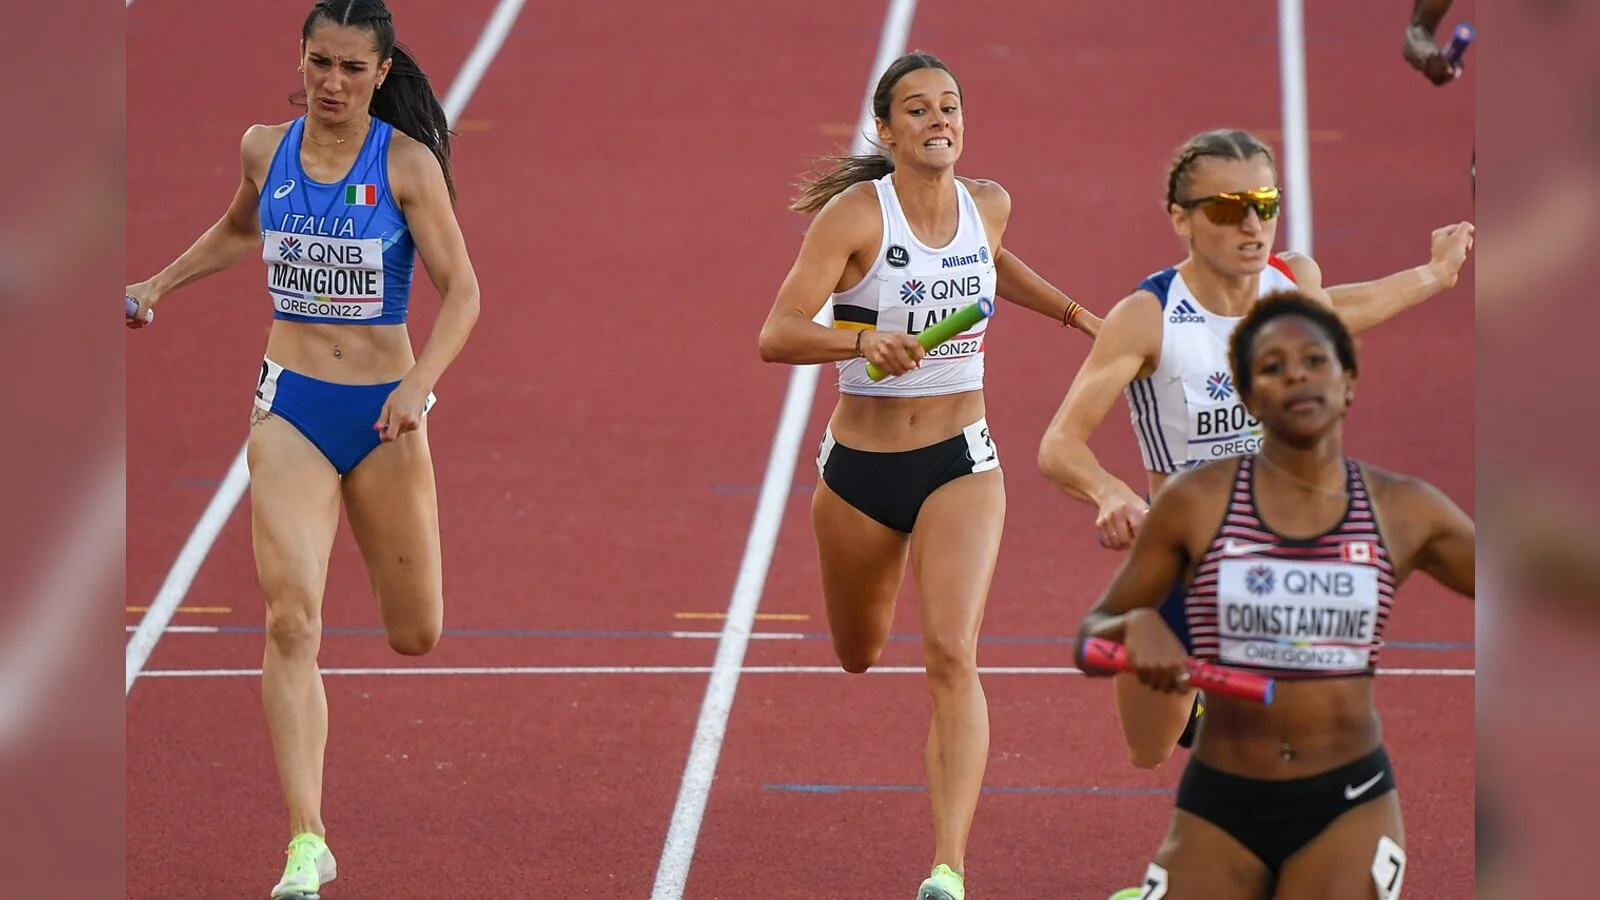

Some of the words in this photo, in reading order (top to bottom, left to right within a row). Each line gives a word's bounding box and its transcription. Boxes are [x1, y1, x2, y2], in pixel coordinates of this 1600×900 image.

[280, 213, 355, 237] ITALIA
[307, 242, 363, 265] QNB
[941, 253, 979, 269] Allianz
[272, 264, 377, 295] MANGIONE
[931, 276, 981, 300] QNB
[280, 298, 362, 317] OREGON22
[1169, 315, 1206, 324] adidas
[907, 308, 972, 335] LA
[924, 341, 978, 357] GON22
[1284, 570, 1355, 597] QNB
[1226, 603, 1371, 639] CONSTANTINE
[1245, 646, 1347, 665] OREGON22
[1389, 856, 1400, 891] 7
